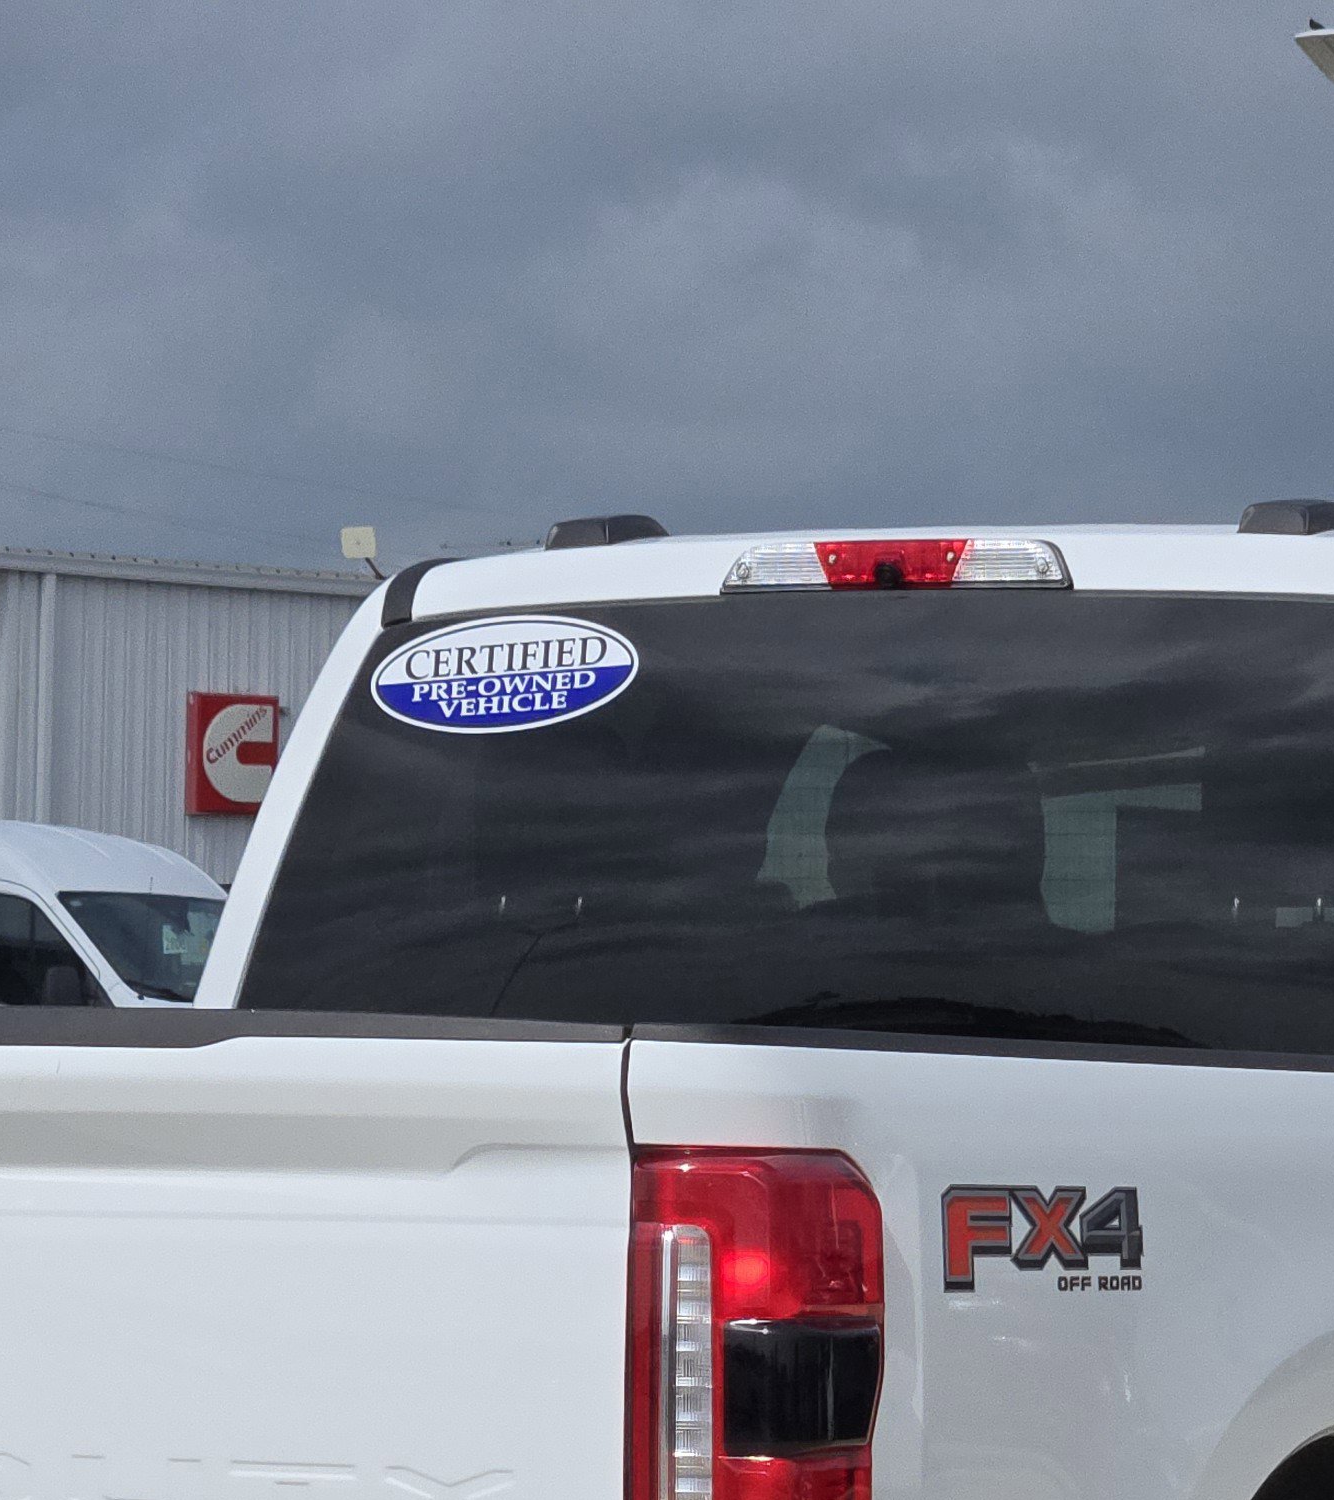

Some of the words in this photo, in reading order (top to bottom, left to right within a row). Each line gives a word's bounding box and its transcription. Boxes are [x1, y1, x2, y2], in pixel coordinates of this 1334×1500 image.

[404, 635, 609, 681] CERTIFIED
[411, 670, 596, 702] PRE-OWNED
[436, 690, 568, 719] VEHICLE
[205, 705, 269, 765] Cummins
[940, 1183, 1144, 1293] FX4
[1057, 1275, 1092, 1292] OFF
[1097, 1275, 1143, 1292] ROAD
